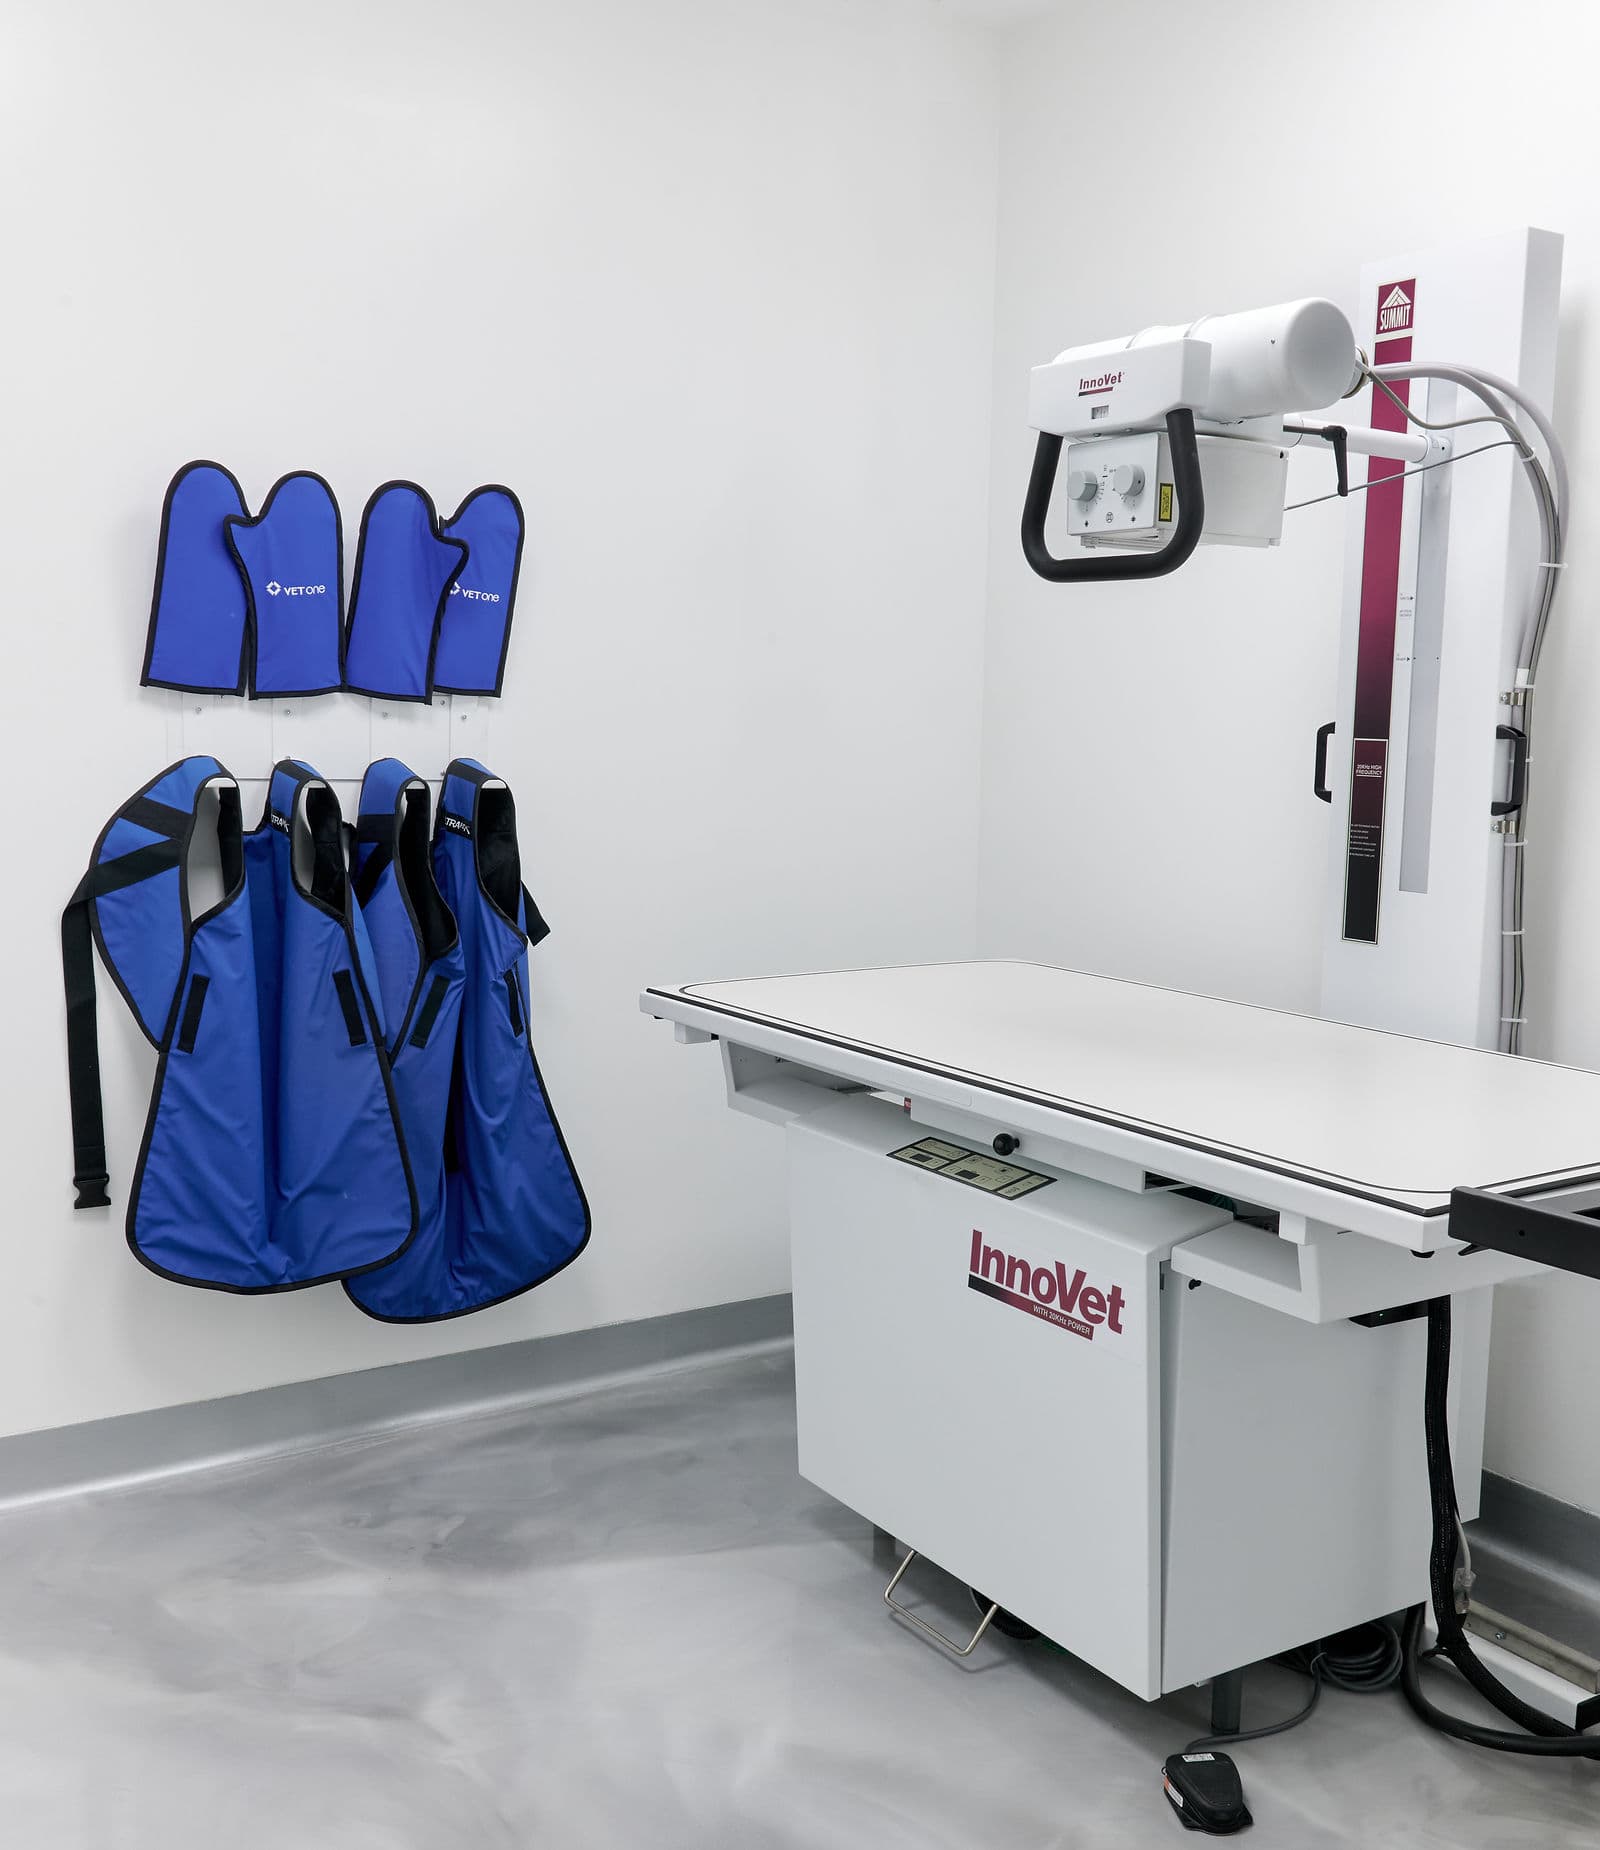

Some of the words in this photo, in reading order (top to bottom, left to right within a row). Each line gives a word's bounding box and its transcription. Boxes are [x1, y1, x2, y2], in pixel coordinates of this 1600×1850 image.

[1380, 304, 1411, 330] SUMMIT
[1080, 371, 1122, 390] InnoVet
[970, 1229, 1126, 1335] InnoVet
[1033, 1304, 1049, 1318] WITH
[1067, 1319, 1091, 1336] POWER
